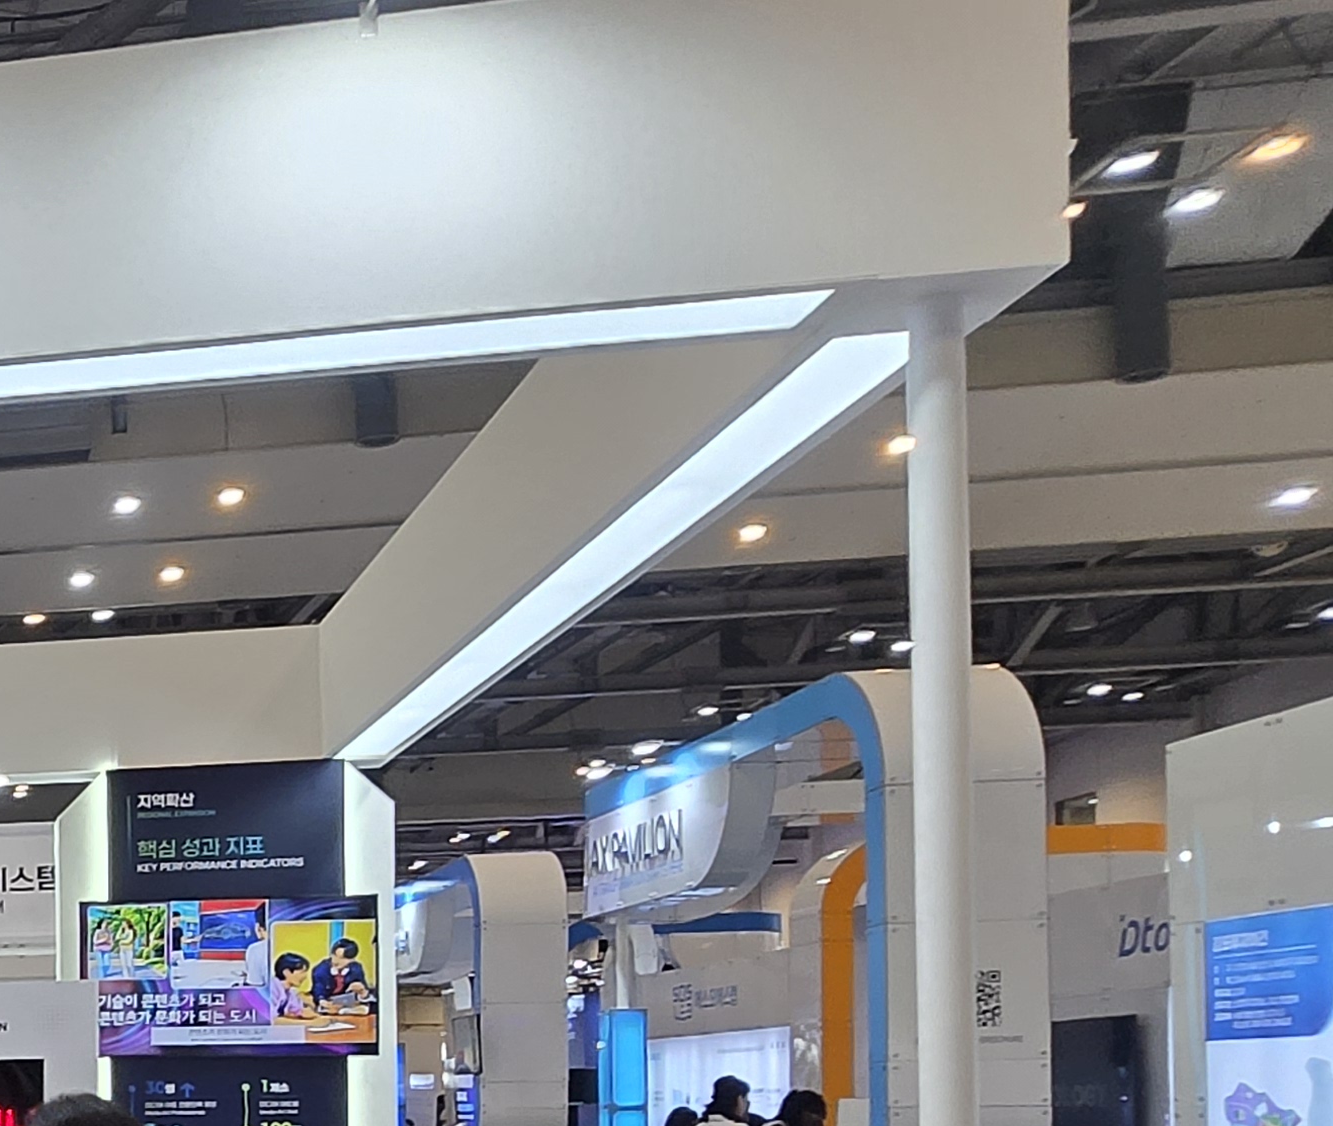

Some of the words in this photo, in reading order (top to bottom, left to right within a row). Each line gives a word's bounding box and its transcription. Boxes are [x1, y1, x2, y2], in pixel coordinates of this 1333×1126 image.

[137, 839, 176, 859] 핵심
[181, 837, 221, 858] 성과
[225, 836, 266, 856] 지표
[136, 862, 158, 873] KEY
[159, 860, 238, 872] PERFORMANCE
[240, 857, 305, 870] INDICATORS
[98, 993, 138, 1010] 기술이
[198, 993, 226, 1007] 되고
[198, 1010, 226, 1024] 되는
[229, 1009, 257, 1023] 도시
